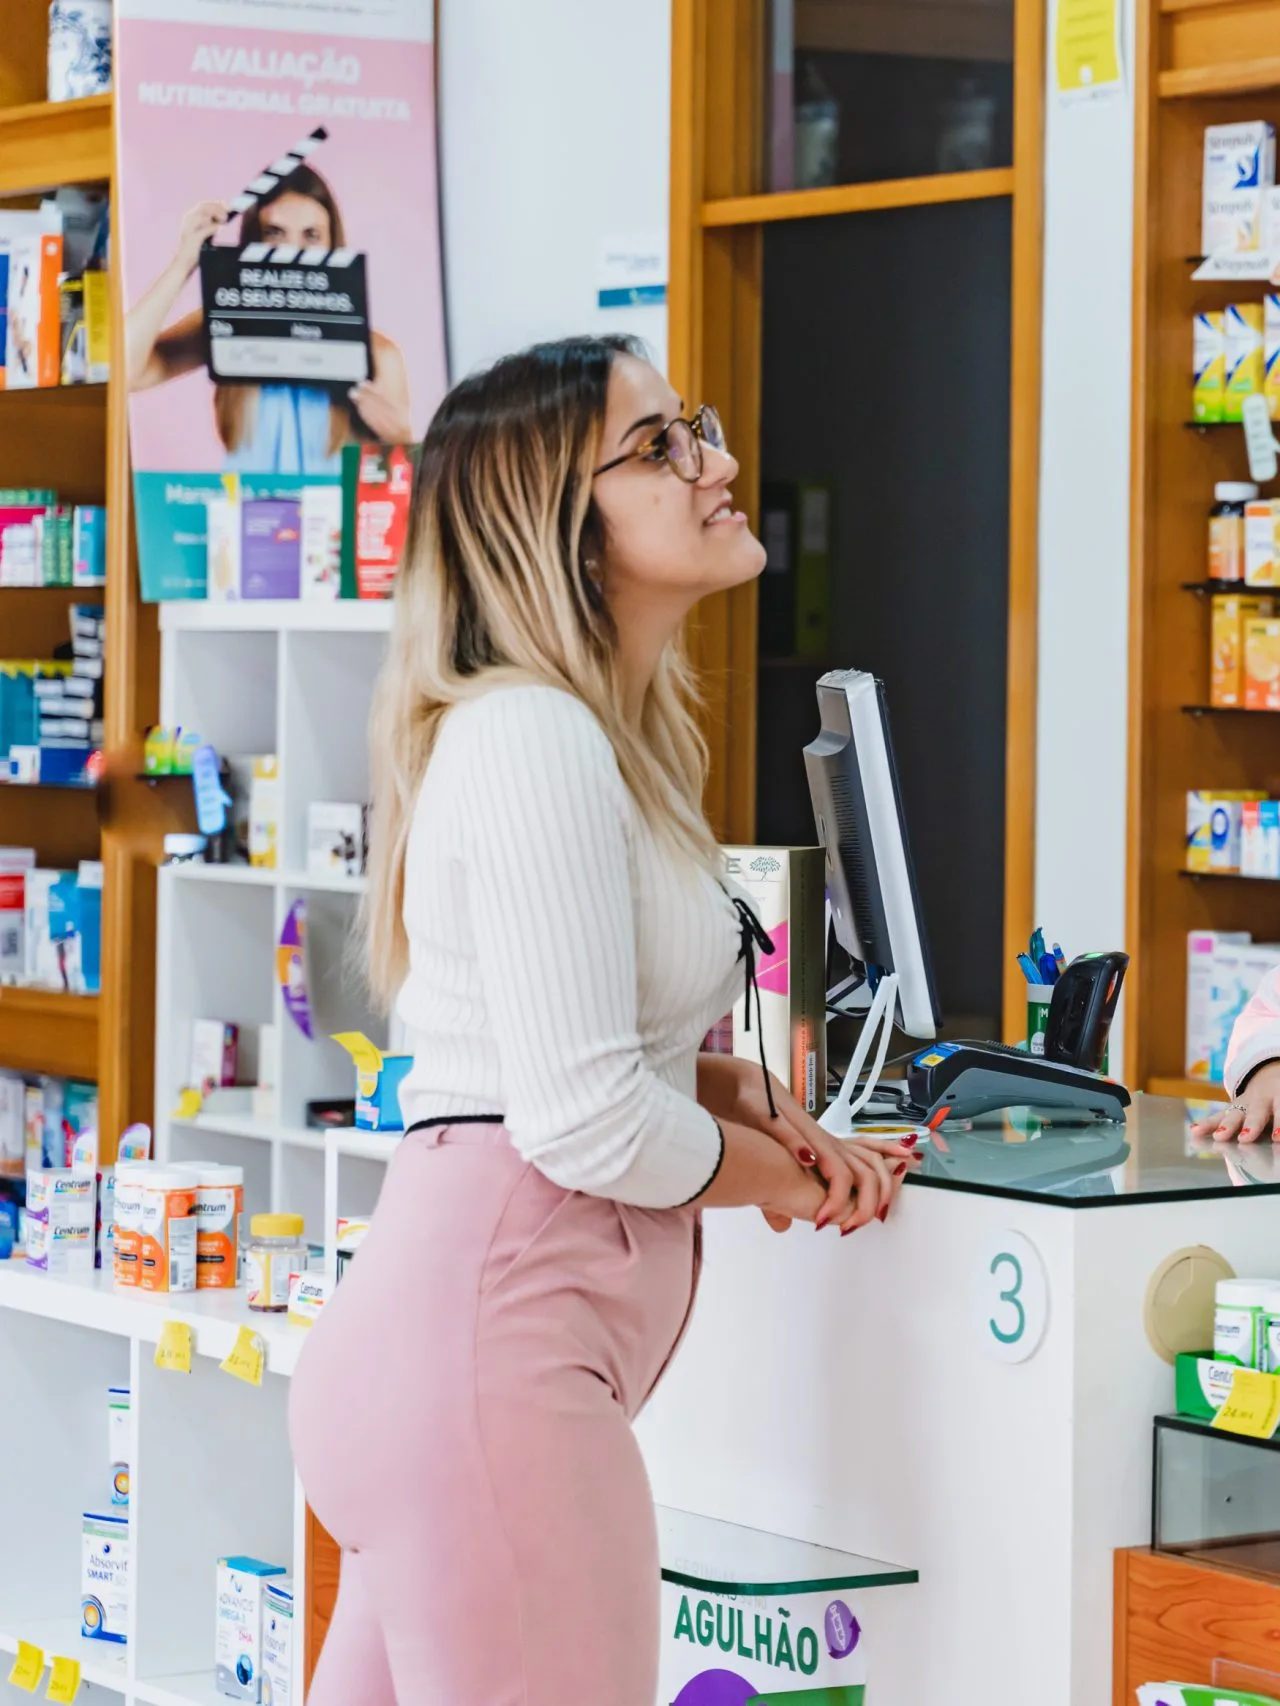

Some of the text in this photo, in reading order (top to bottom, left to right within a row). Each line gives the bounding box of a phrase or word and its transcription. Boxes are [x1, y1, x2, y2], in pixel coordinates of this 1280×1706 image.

[190, 45, 361, 89] AVALIAÇÃO
[138, 82, 410, 121] NUTRICIONAL GRATUITA
[241, 288, 286, 308] SEUS
[55, 1178, 92, 1192] Centrum
[53, 1224, 90, 1238] Centrum
[990, 1252, 1025, 1344] 3
[1208, 1366, 1233, 1383] Centr
[673, 1594, 819, 1676] AGULHÃO
